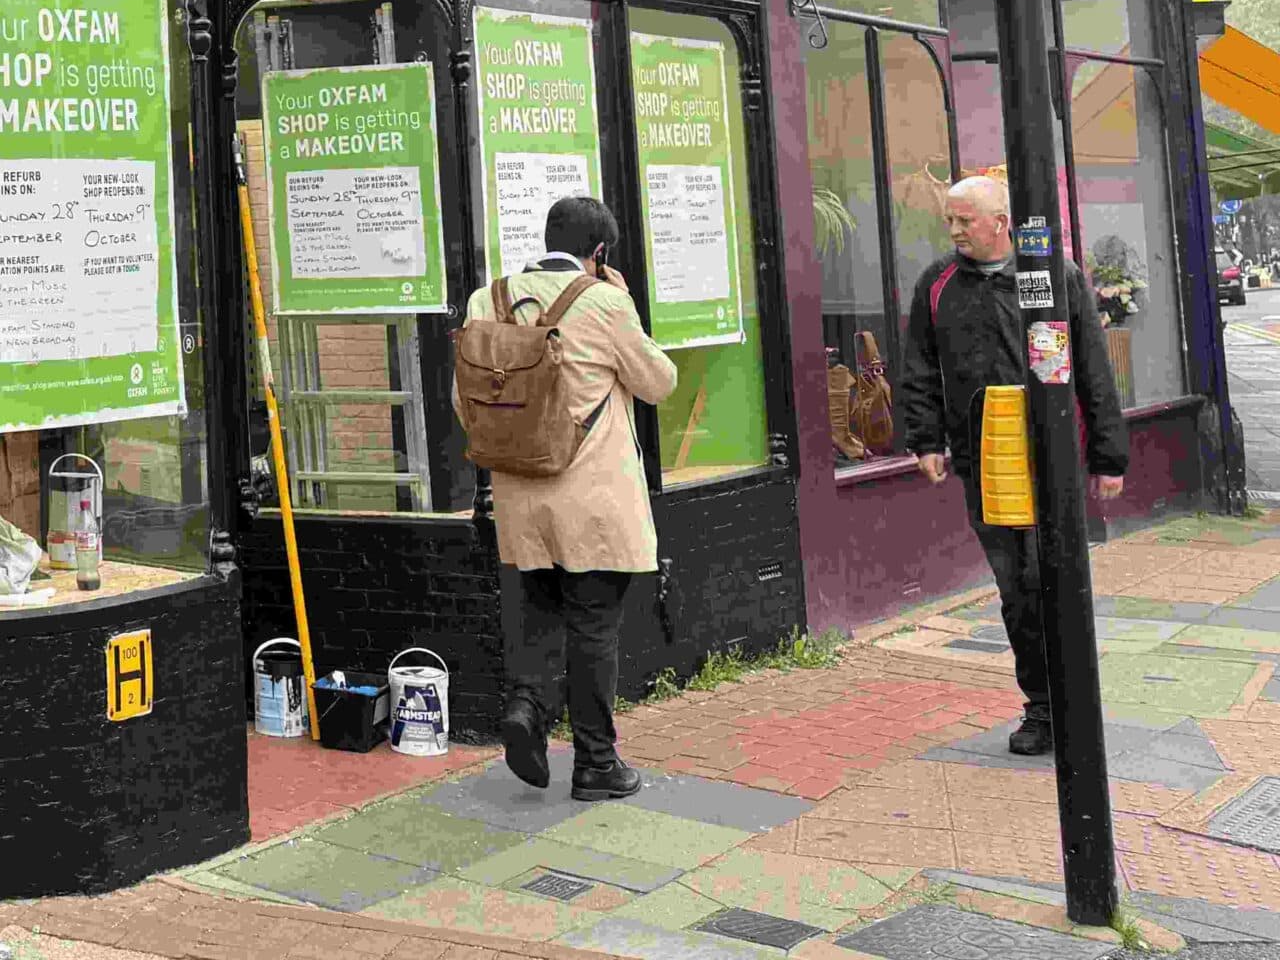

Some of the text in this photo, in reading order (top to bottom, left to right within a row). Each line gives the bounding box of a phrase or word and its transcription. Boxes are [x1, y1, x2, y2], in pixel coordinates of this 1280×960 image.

[38, 8, 120, 44] OXFAM
[484, 40, 563, 67] Your OXFAM
[60, 58, 79, 87] is
[86, 59, 155, 95] getting
[635, 62, 700, 87] Your OXFAM
[275, 83, 387, 111] Your OXFAM
[486, 73, 586, 107] SHOP is getting
[637, 92, 720, 122] SHOP is getting
[278, 109, 420, 134] SHOP is getting
[489, 107, 577, 133] a MAKEOVER
[280, 132, 404, 159] a MAKEOVER
[641, 123, 712, 148] a MAKEOVER
[3, 171, 41, 182] REFURB
[83, 174, 102, 185] YOUR
[20, 185, 36, 194] ON:
[83, 188, 103, 198] SHOP
[104, 186, 135, 197] REOPENS
[84, 209, 134, 224] THURSDAY
[84, 230, 137, 248] OCTOBER
[6, 255, 40, 265] NEAREST
[23, 265, 49, 275] POINTS
[122, 647, 138, 660] 100
[114, 640, 146, 712] H
[128, 693, 135, 705] 2
